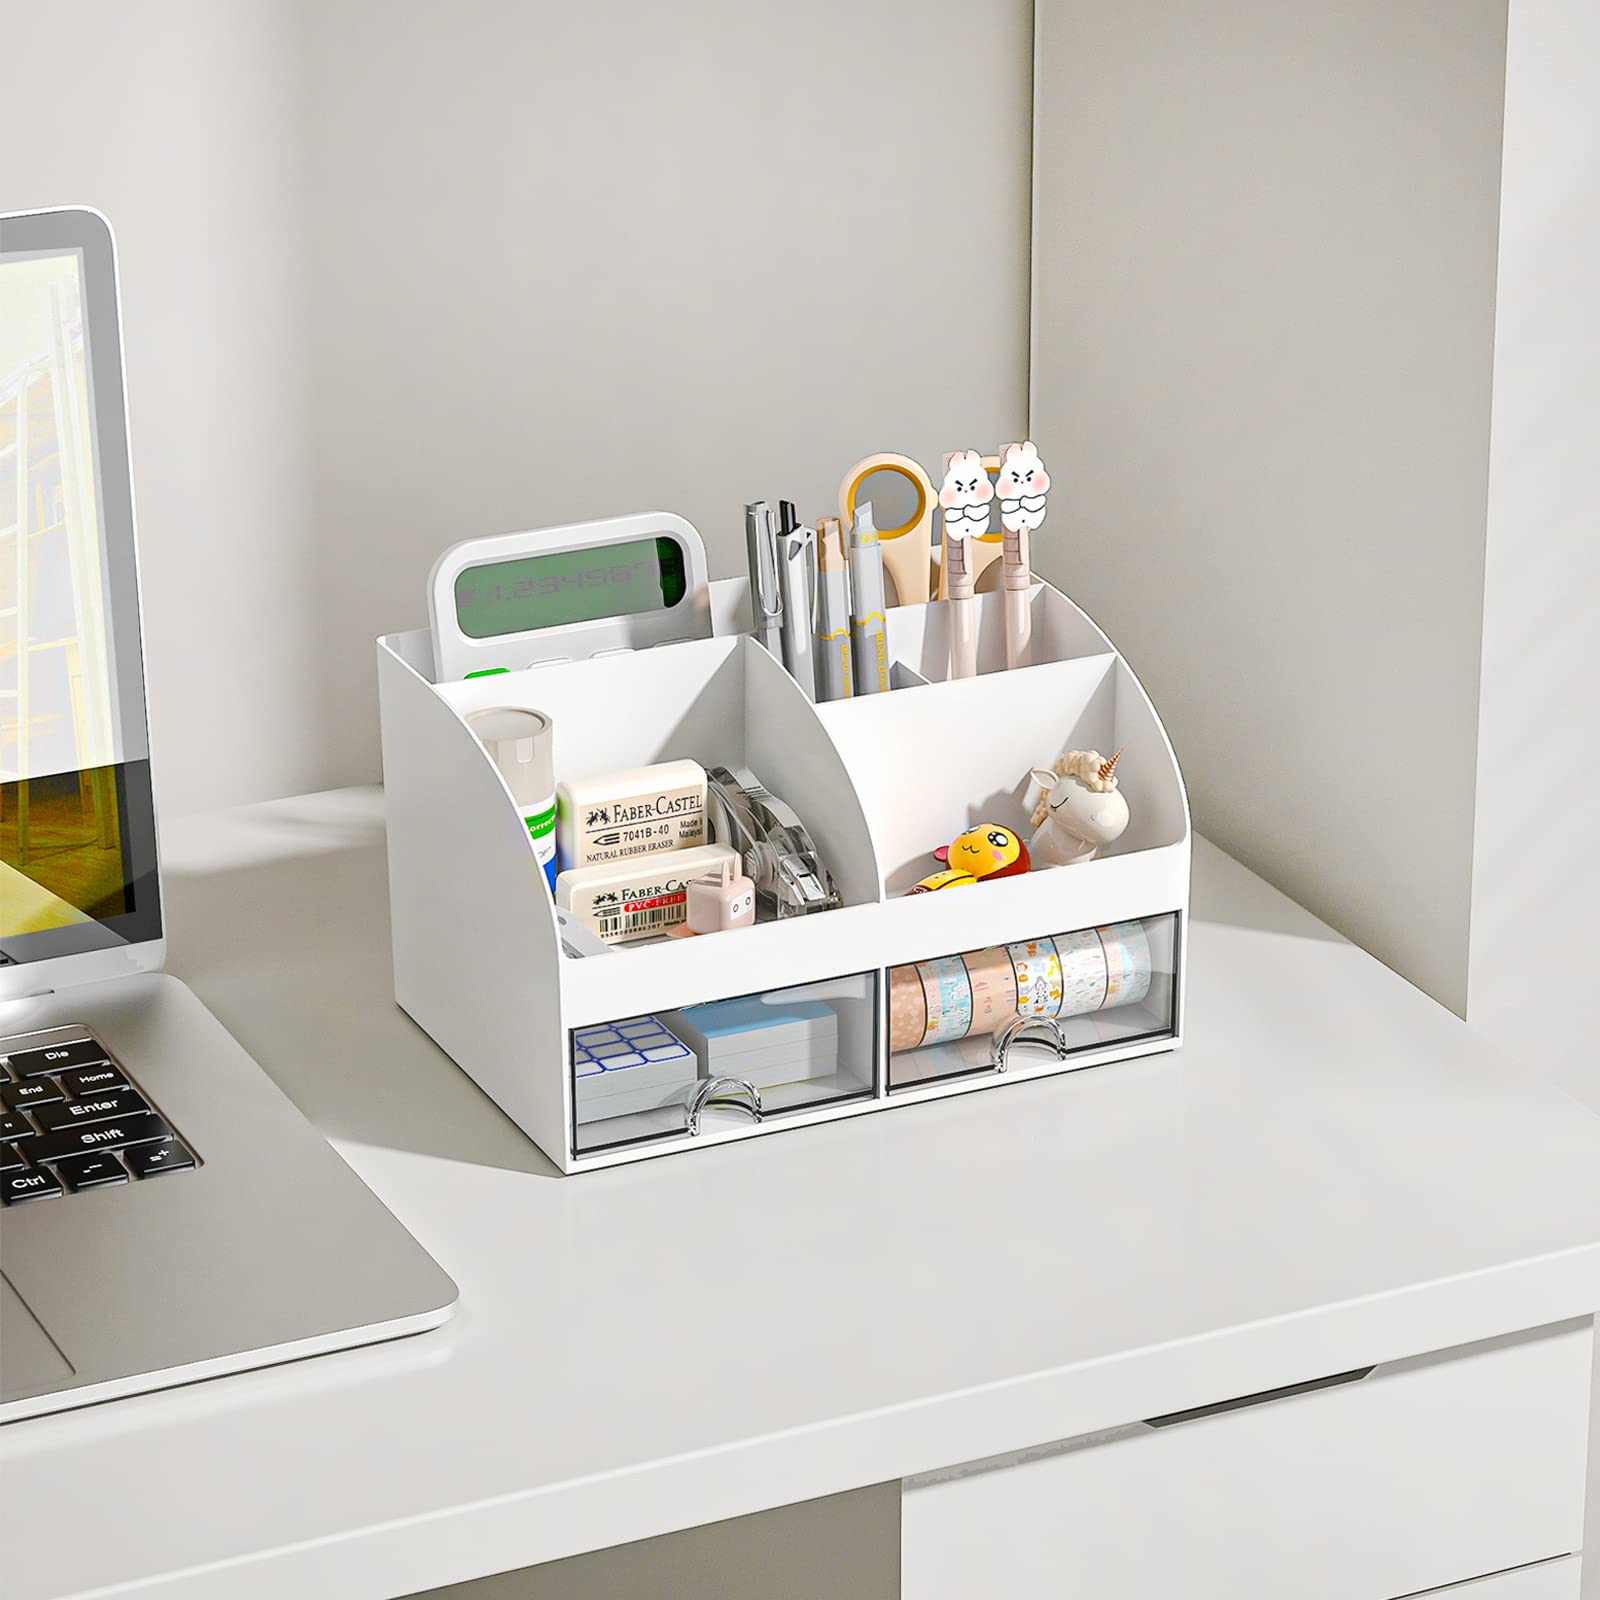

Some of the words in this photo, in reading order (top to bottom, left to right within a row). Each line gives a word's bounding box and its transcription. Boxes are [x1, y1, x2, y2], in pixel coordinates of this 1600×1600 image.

[586, 850, 618, 863] NATURAL
[619, 844, 648, 857] RUBBER
[648, 839, 674, 852] ERASER
[79, 1071, 115, 1084] Home
[19, 1085, 44, 1096] End
[69, 1099, 119, 1116] Enter
[80, 1128, 125, 1144] Shift
[11, 1175, 46, 1189] Ctrl
